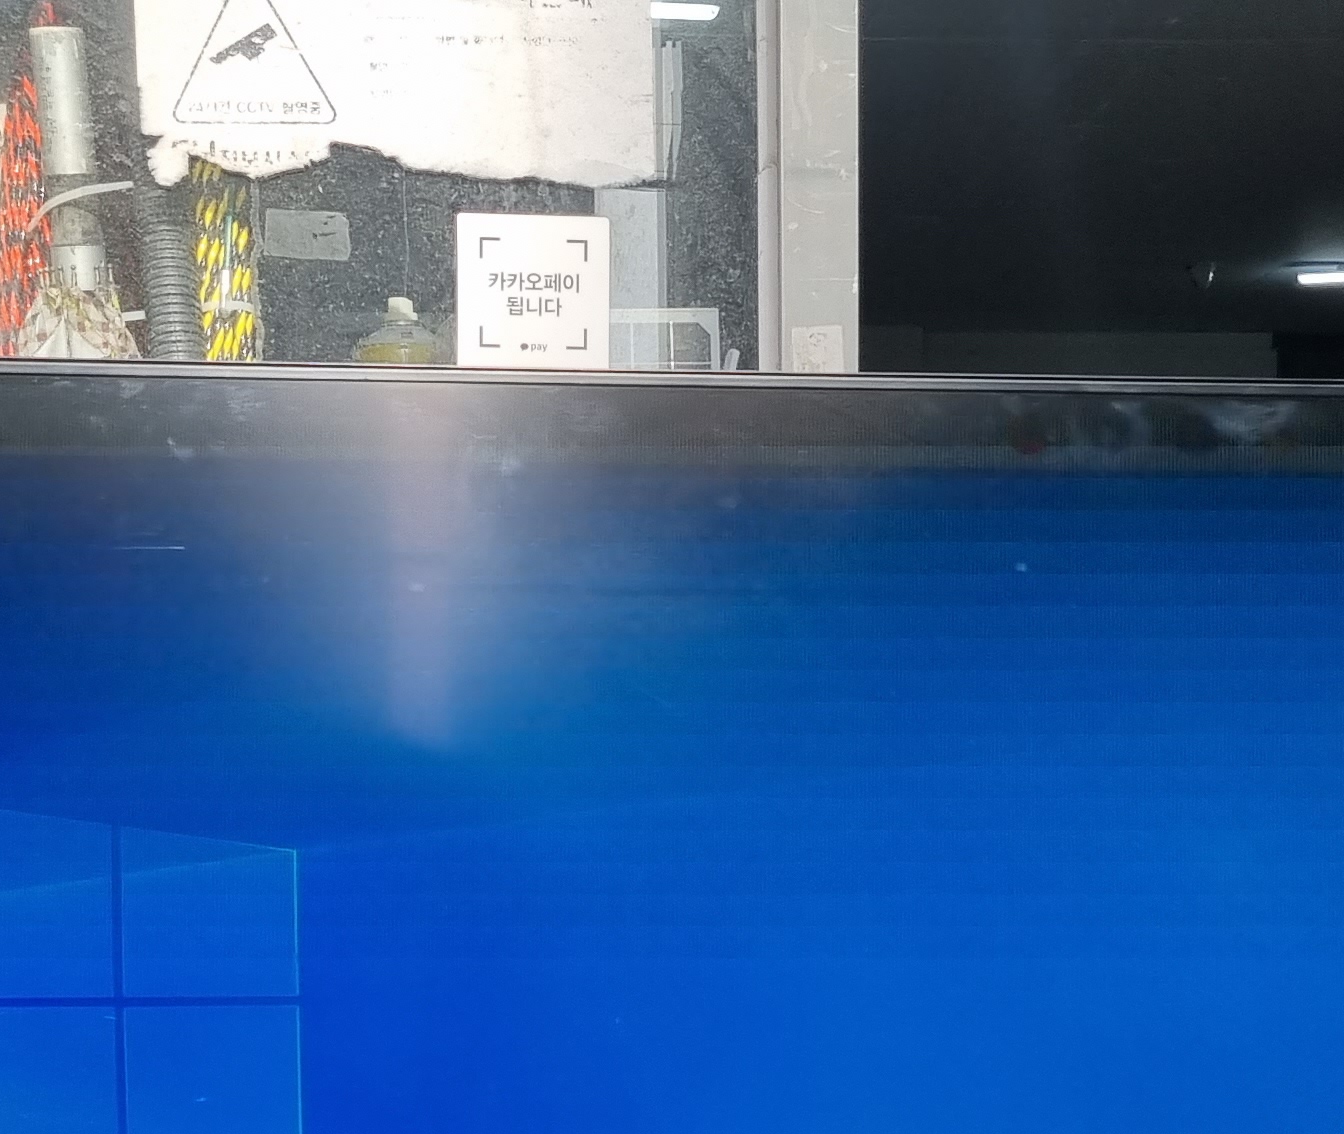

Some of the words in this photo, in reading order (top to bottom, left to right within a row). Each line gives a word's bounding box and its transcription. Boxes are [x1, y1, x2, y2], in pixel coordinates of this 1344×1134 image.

[488, 272, 580, 293] 카카오페이
[506, 296, 562, 317] 됩니다
[530, 343, 548, 353] pay
